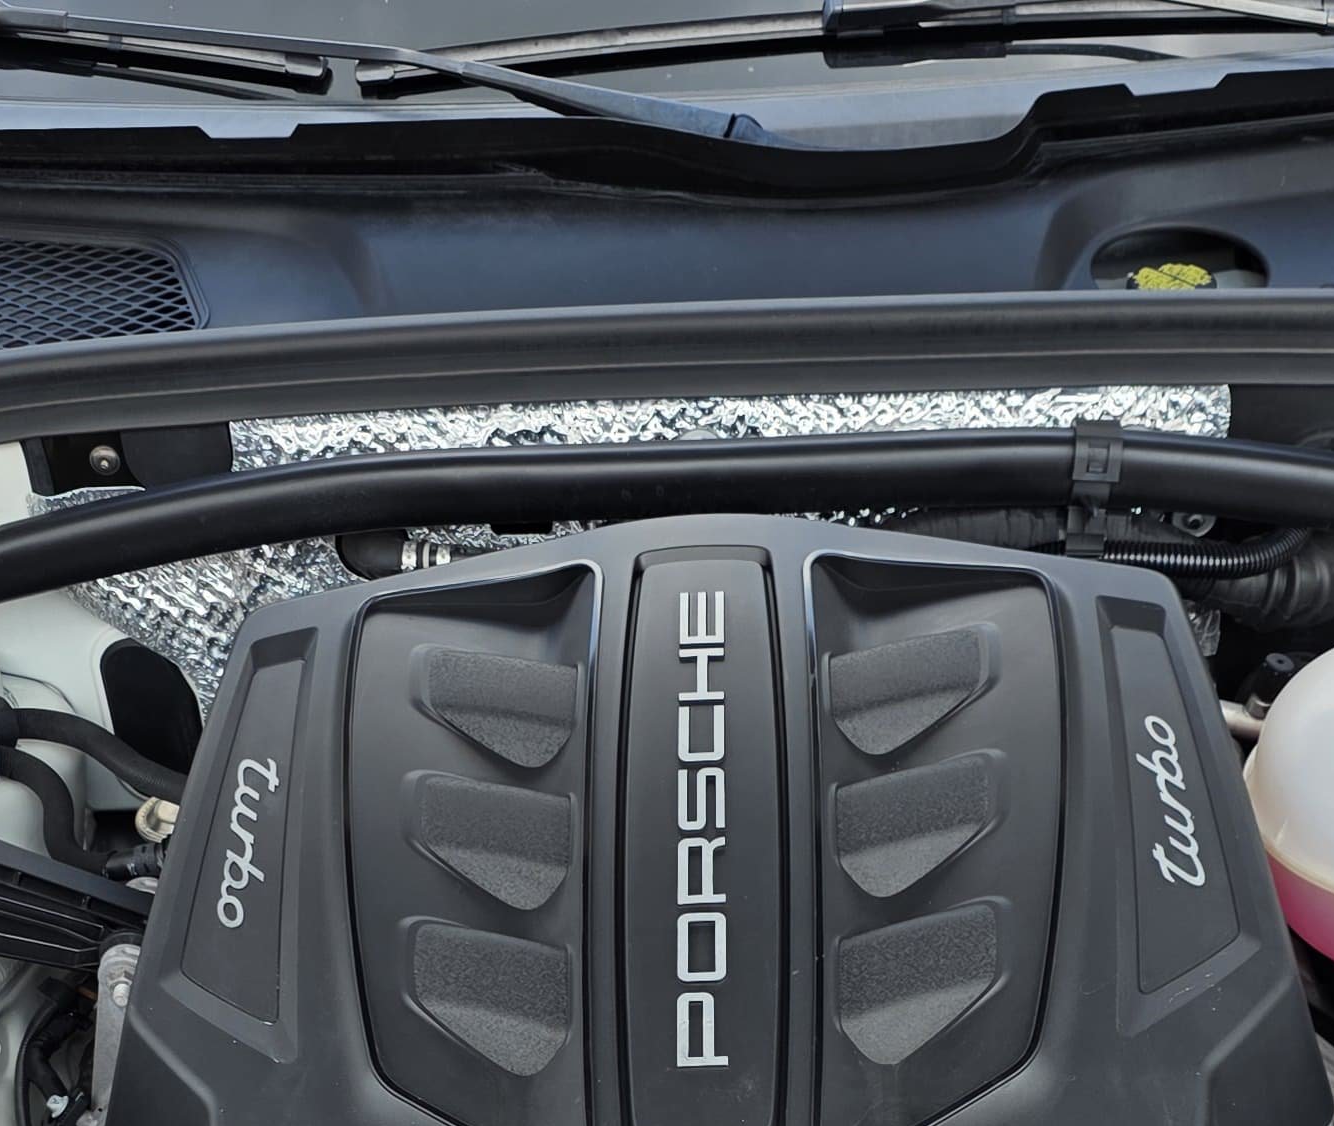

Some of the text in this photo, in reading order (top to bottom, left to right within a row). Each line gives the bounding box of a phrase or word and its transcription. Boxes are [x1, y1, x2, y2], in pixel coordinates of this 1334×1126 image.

[217, 758, 279, 928] turbo
[676, 590, 729, 1067] PORSCHE
[1135, 715, 1206, 887] turbo
